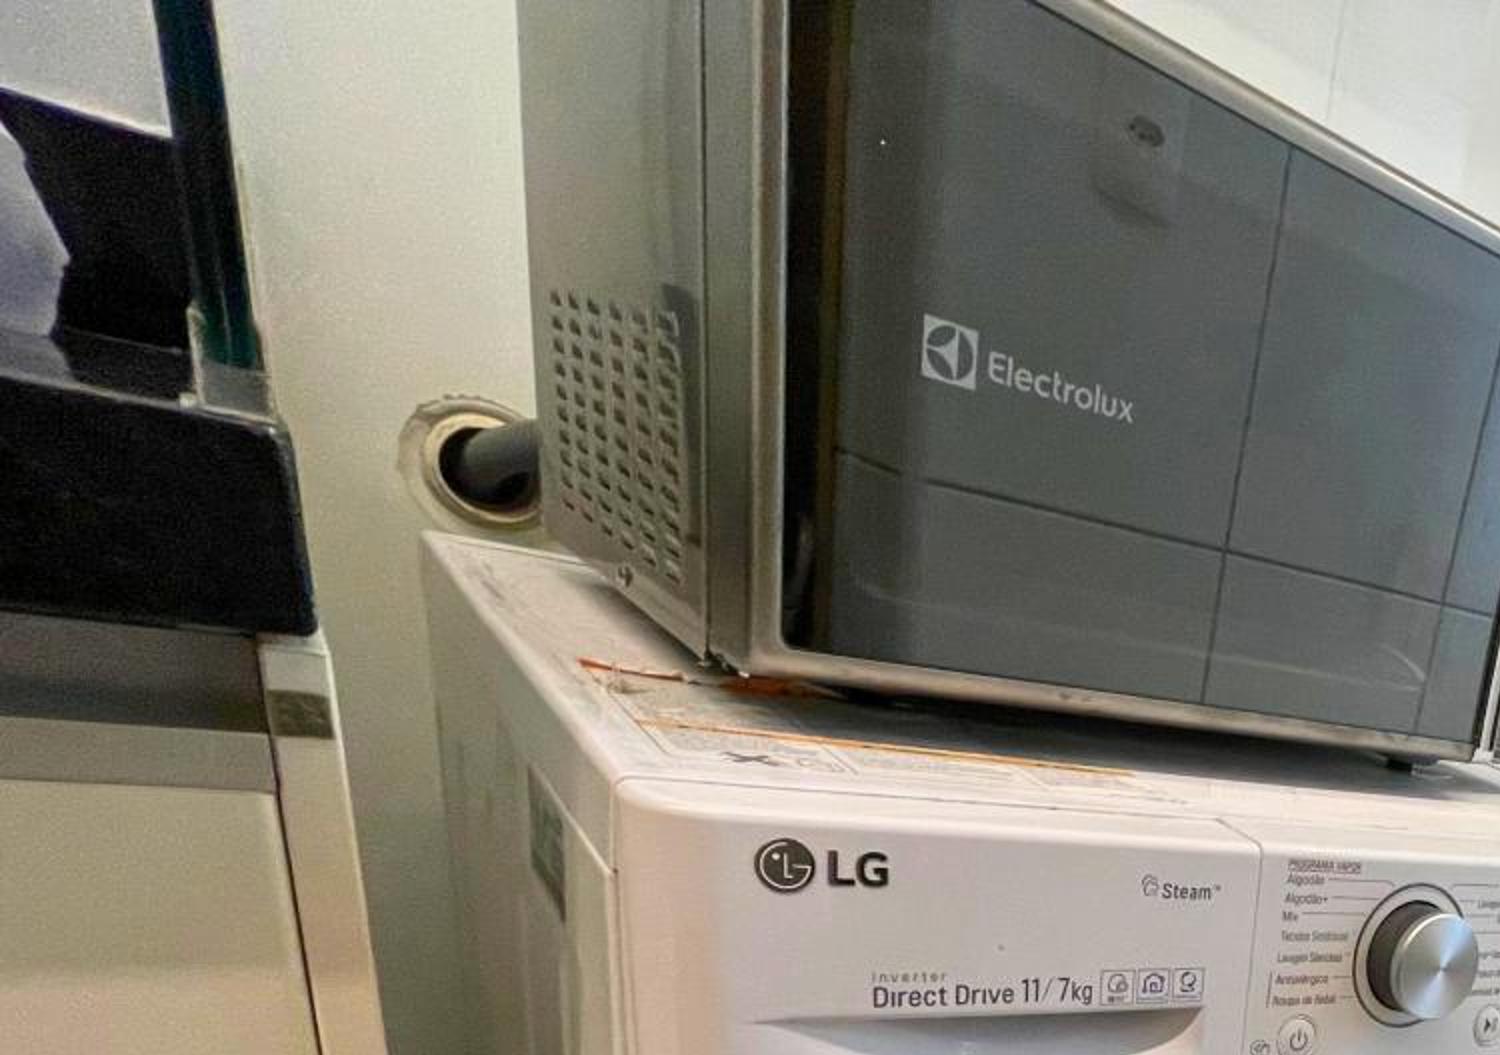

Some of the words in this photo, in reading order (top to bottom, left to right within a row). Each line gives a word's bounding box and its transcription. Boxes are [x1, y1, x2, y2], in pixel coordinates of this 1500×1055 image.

[987, 351, 1133, 423] Electrolux
[827, 850, 889, 888] LG
[872, 985, 948, 1009] Direct
[954, 984, 1015, 1006] Drive
